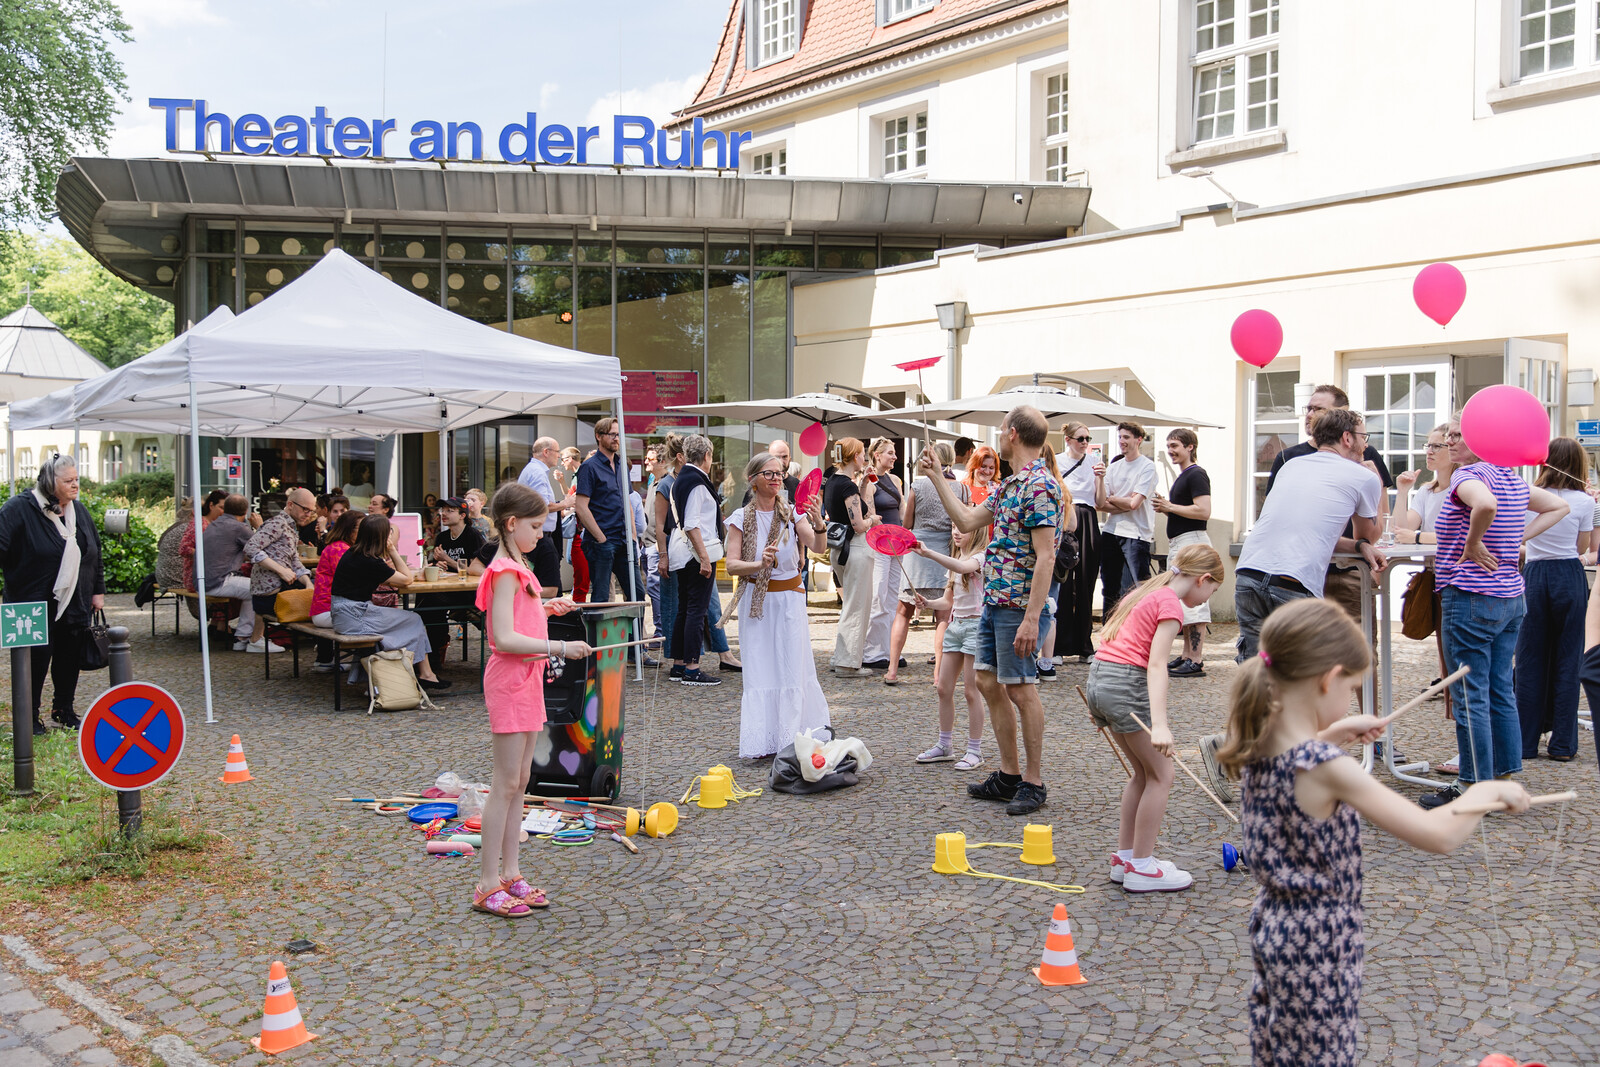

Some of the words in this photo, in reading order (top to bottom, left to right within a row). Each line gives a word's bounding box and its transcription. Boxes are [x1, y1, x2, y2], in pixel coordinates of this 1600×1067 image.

[148, 97, 396, 160] Theater
[409, 120, 483, 164] an
[498, 111, 601, 167] der
[613, 115, 753, 171] Ruhr
